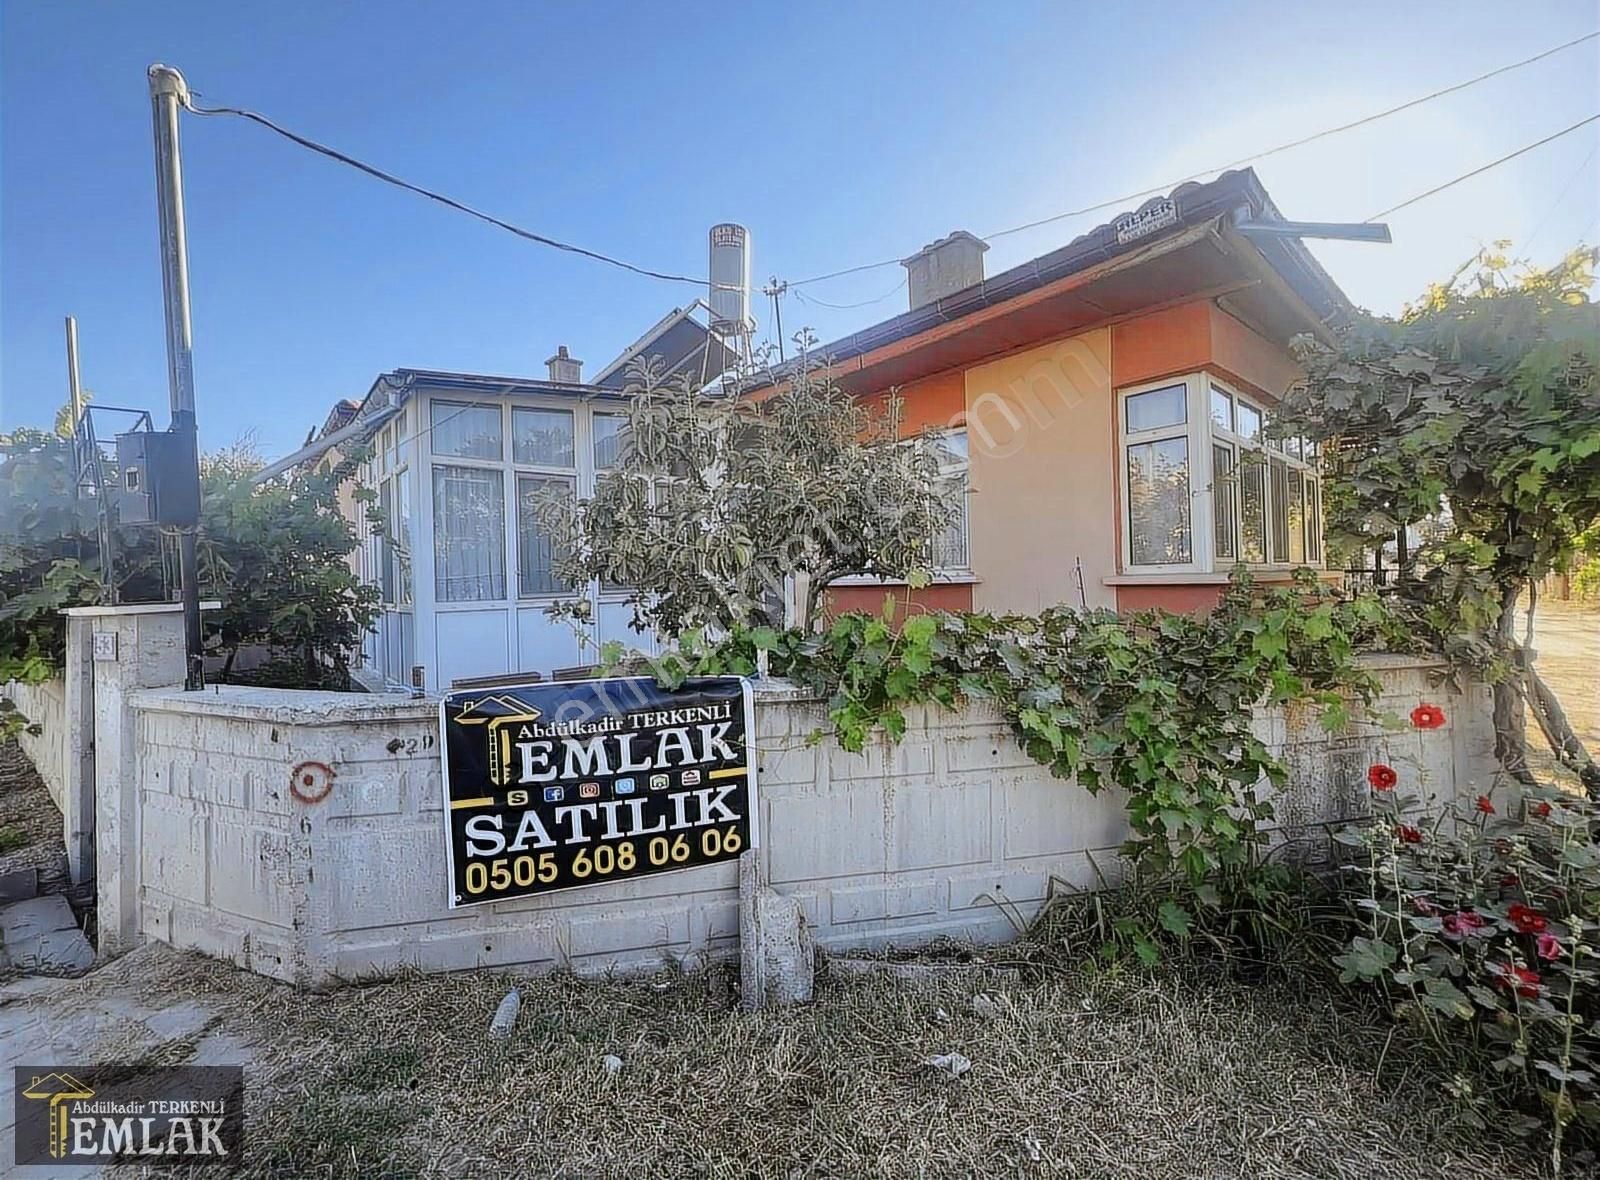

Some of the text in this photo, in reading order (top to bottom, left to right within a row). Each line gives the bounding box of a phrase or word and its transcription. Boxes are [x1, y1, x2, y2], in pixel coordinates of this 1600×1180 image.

[515, 721, 738, 784] EMLAK
[518, 700, 732, 740] Abdülkadir TERKENLİ
[465, 785, 741, 858] SATILIK
[465, 825, 742, 894] 0505 608 06 06
